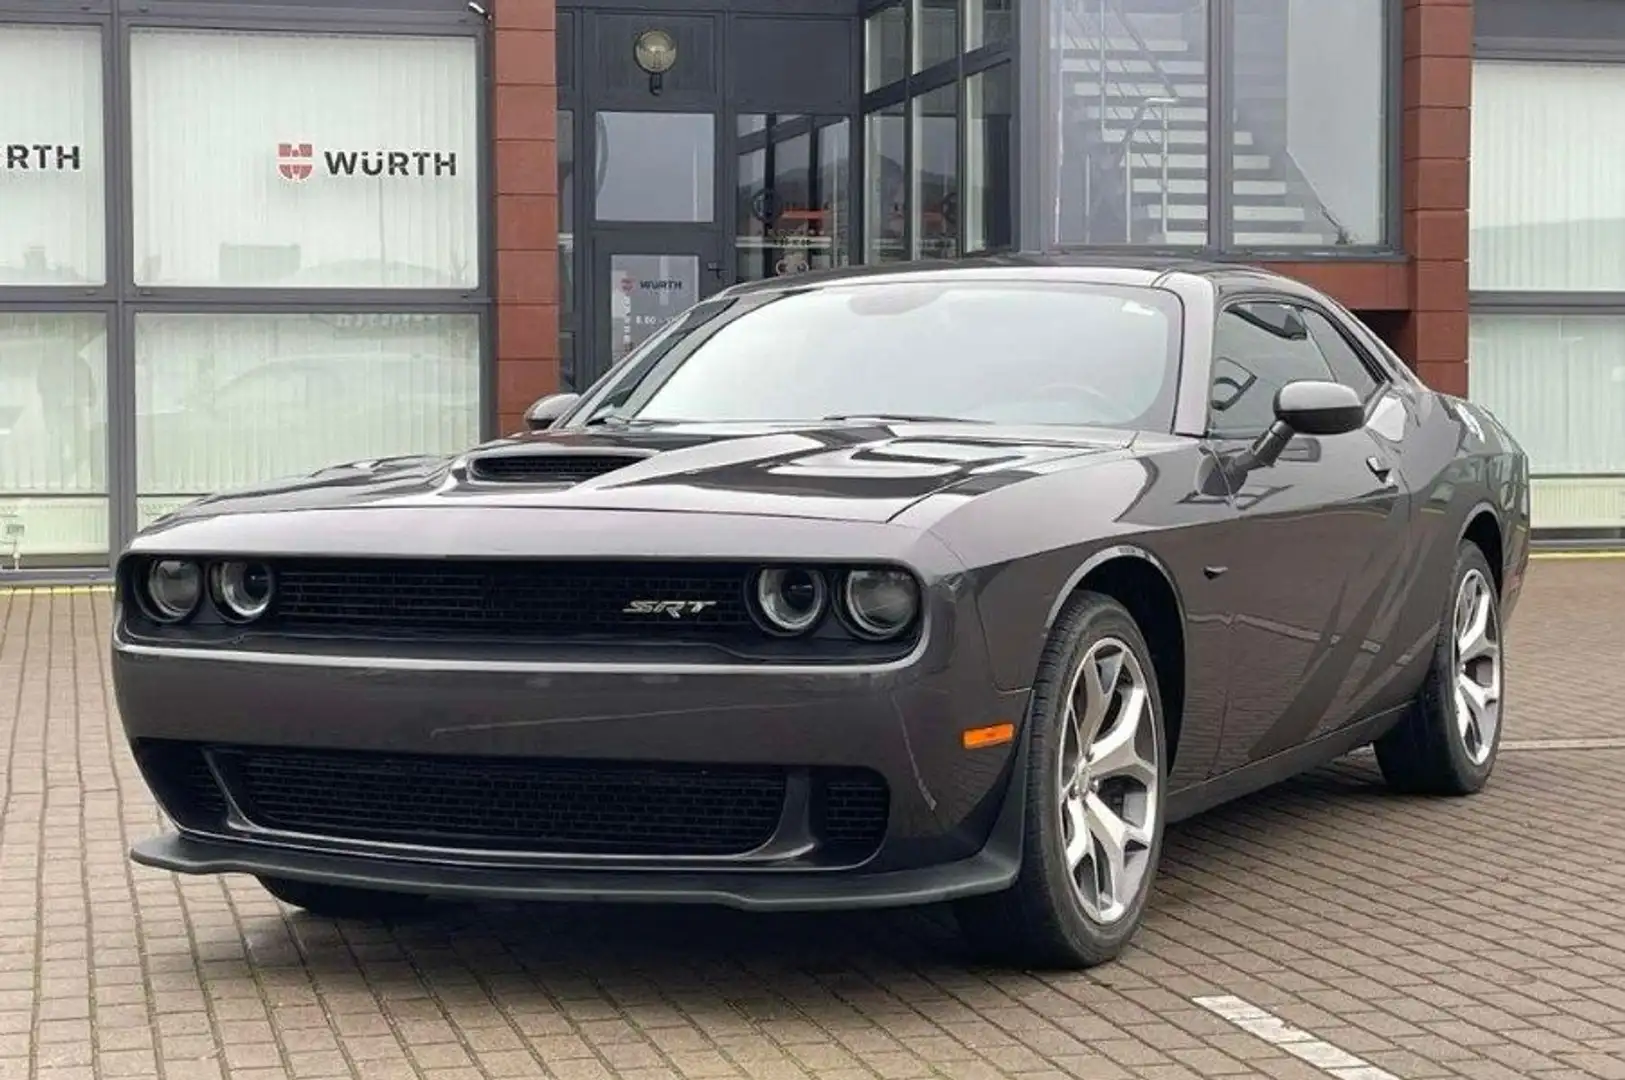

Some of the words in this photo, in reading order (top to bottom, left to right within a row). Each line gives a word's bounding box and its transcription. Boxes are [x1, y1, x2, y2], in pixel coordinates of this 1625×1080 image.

[7, 145, 80, 169] RTH
[324, 151, 457, 176] WÜRTH
[622, 600, 717, 619] SRT
